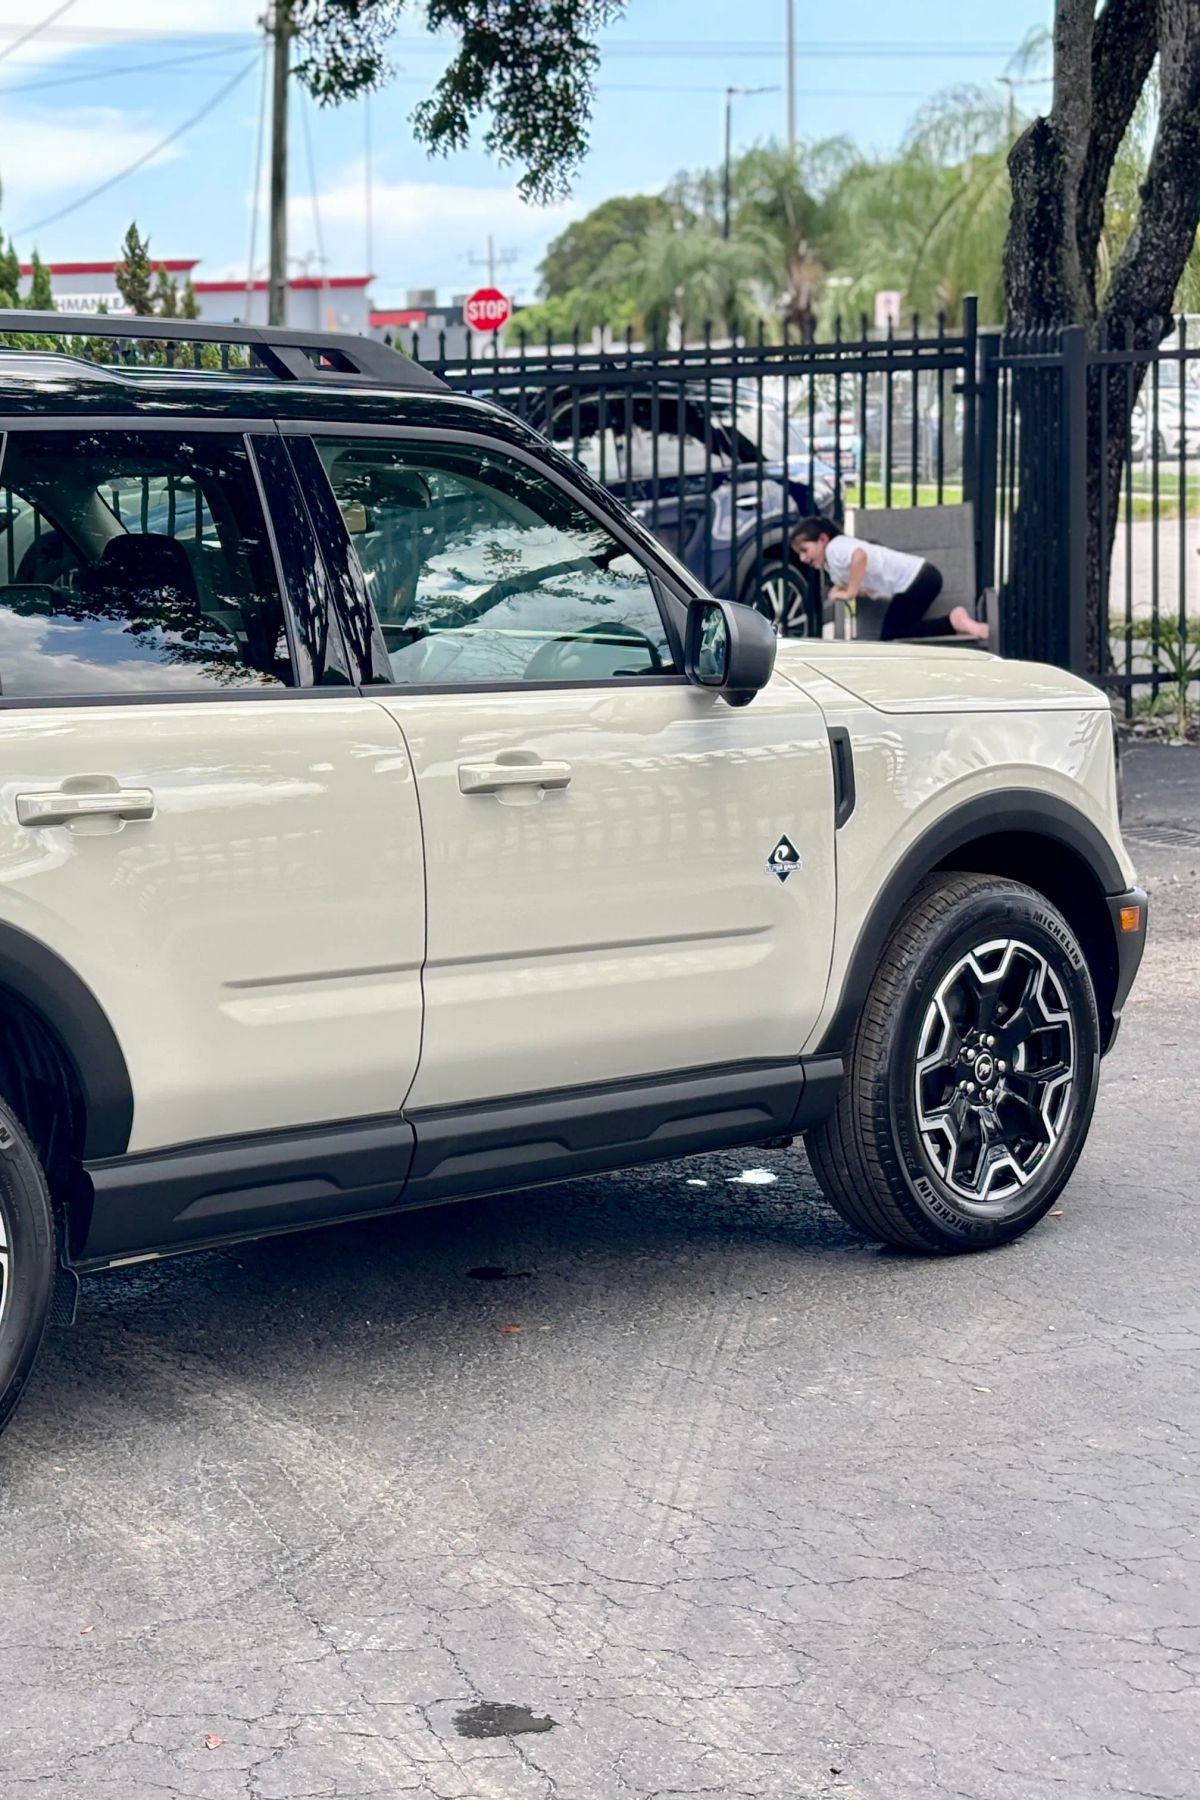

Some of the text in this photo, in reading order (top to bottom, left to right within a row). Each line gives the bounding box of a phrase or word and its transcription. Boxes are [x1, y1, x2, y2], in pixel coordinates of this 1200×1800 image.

[468, 300, 507, 320] STOP
[1032, 911, 1080, 965] MICHELIN
[917, 1179, 973, 1233] MICHELIN
